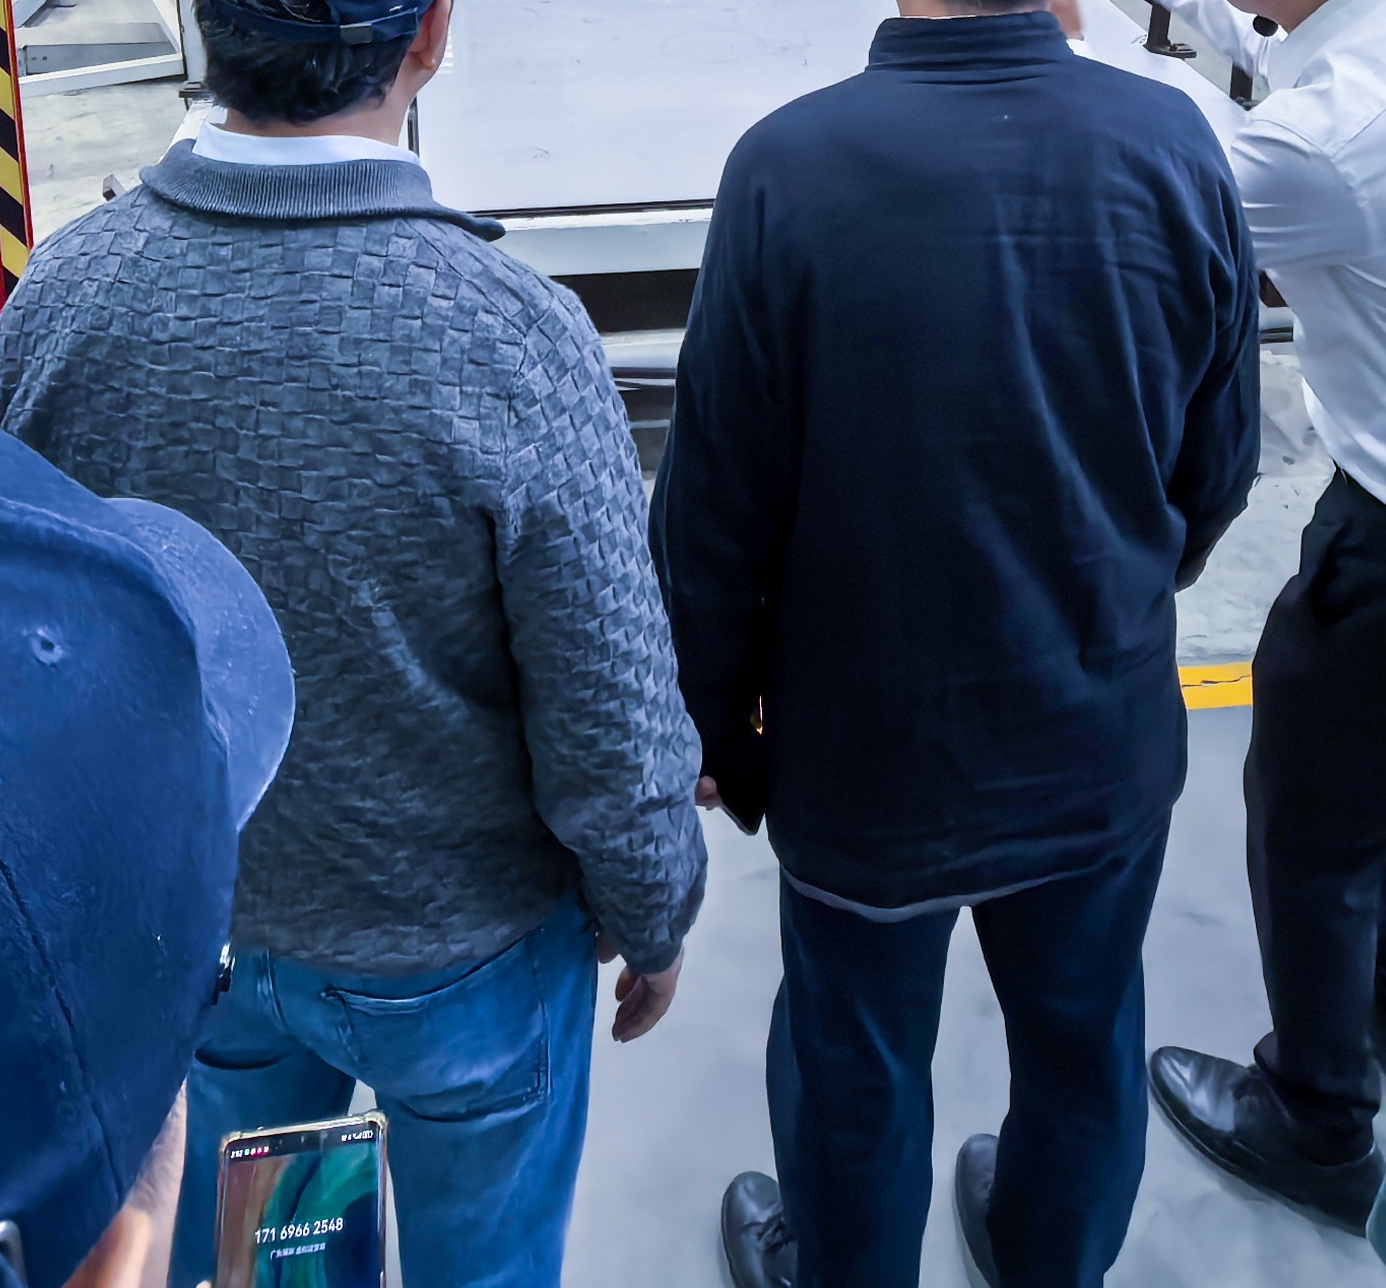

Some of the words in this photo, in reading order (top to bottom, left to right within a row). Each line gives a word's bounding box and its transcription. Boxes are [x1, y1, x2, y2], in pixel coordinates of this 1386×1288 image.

[254, 1227, 276, 1244] 171
[280, 1221, 310, 1241] 6966
[313, 1217, 344, 1235] 2548
